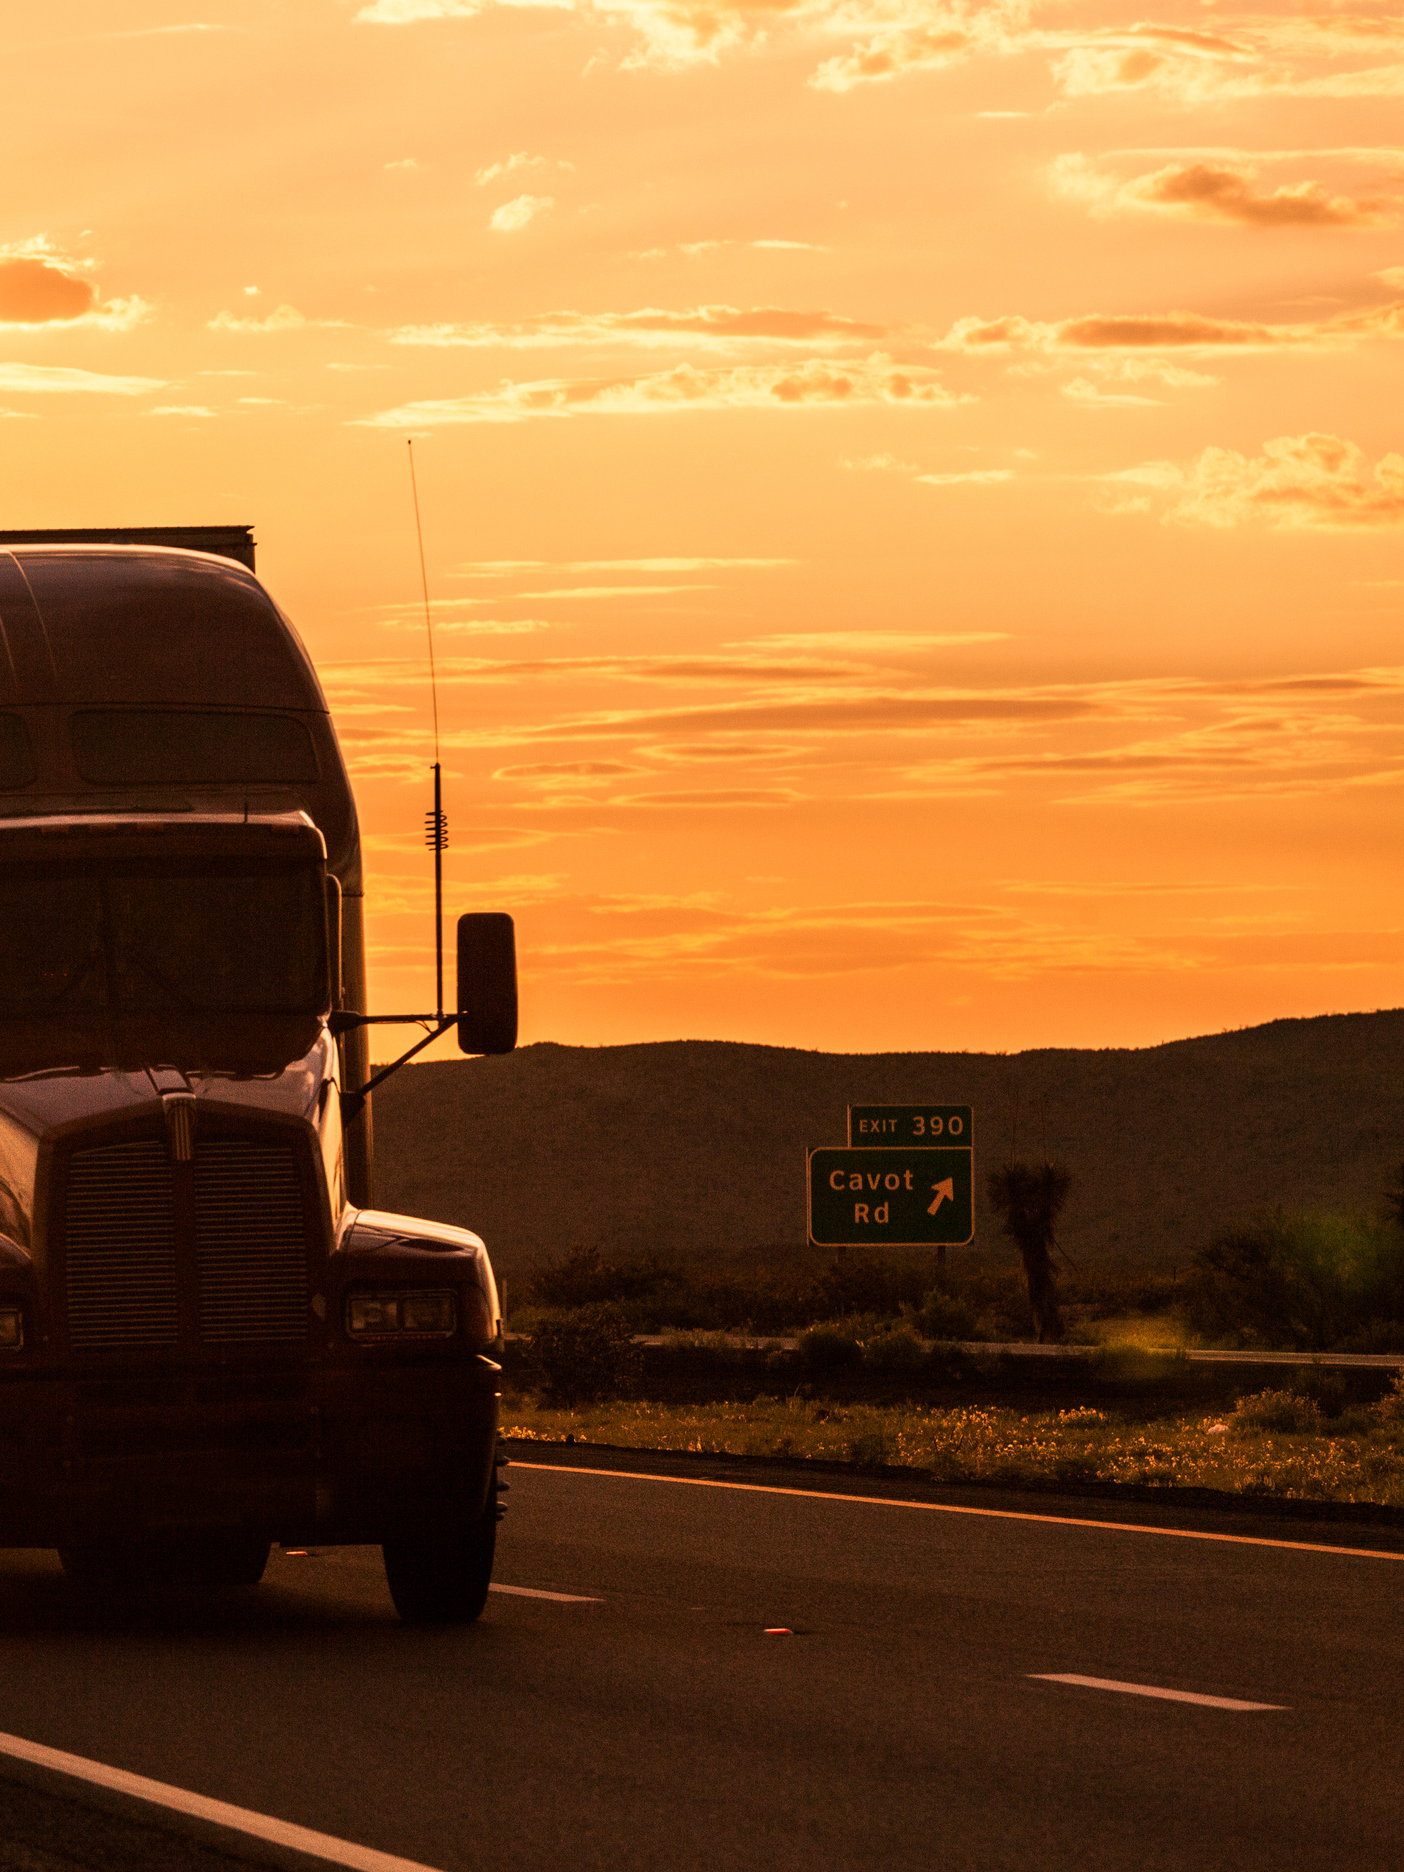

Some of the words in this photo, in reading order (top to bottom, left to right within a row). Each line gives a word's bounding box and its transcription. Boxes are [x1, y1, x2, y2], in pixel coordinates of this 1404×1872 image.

[859, 1119, 898, 1133] EXIT
[912, 1116, 964, 1136] 390
[829, 1169, 914, 1191] Cavot
[854, 1201, 889, 1224] Rd
